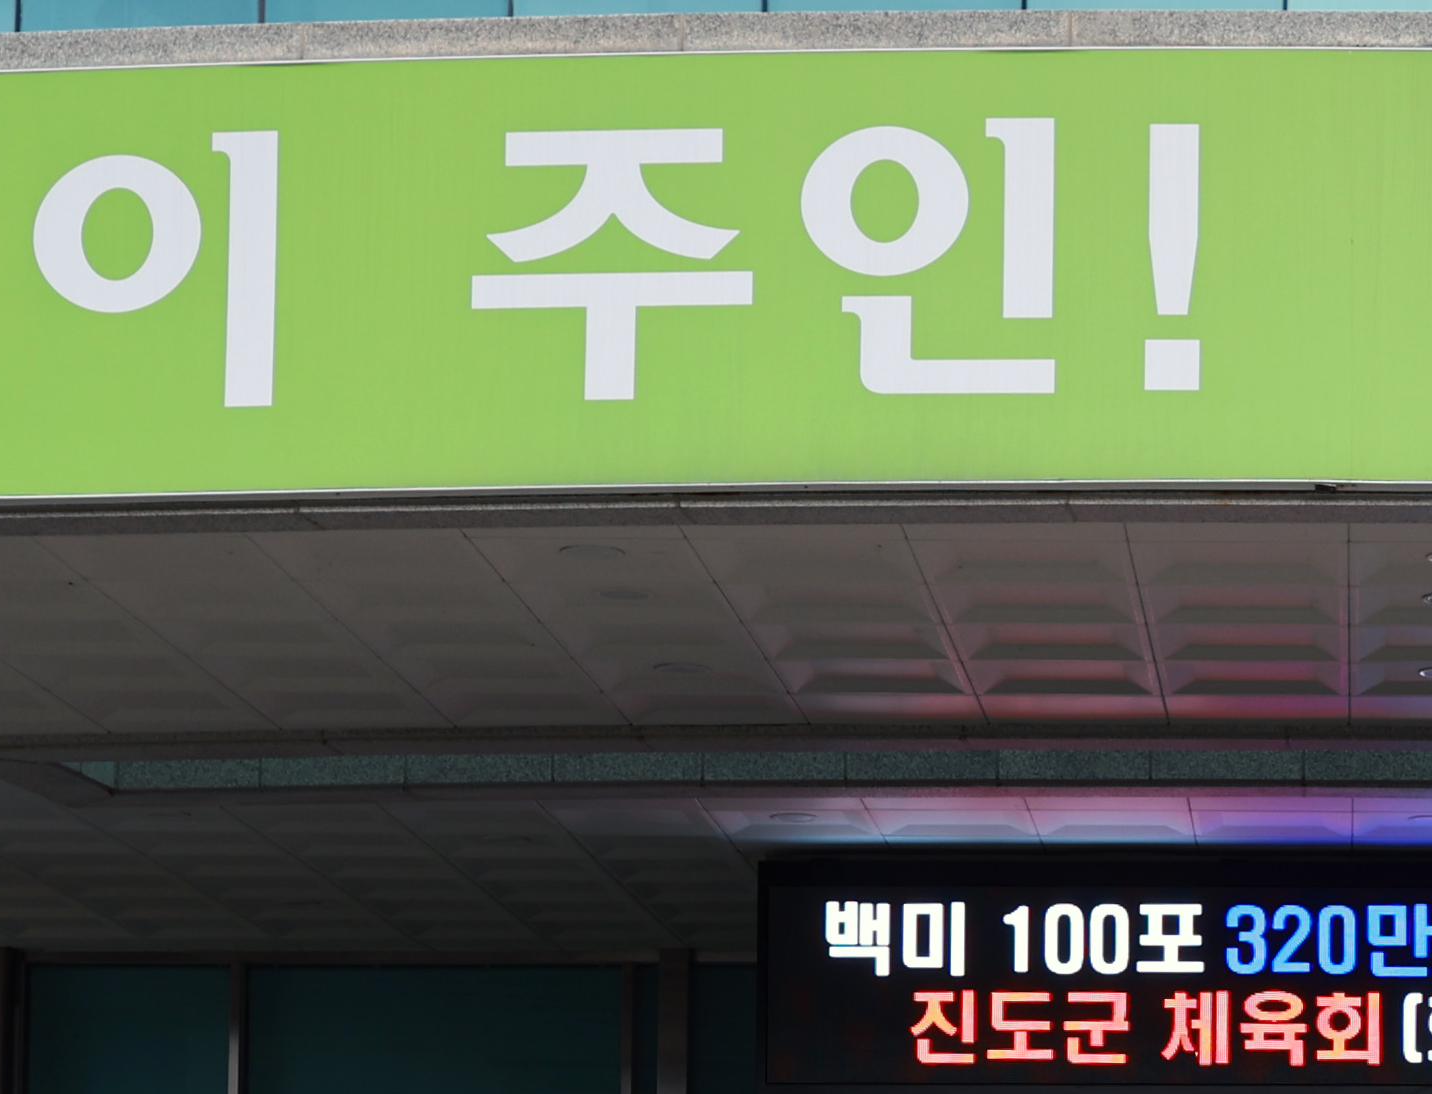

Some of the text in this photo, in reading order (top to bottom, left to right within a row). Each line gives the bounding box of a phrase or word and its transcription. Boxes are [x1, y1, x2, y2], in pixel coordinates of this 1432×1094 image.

[472, 116, 1202, 402] 주인!
[824, 901, 967, 978] 백미
[1003, 903, 1206, 976] 100포
[910, 989, 1132, 1067] 진도군
